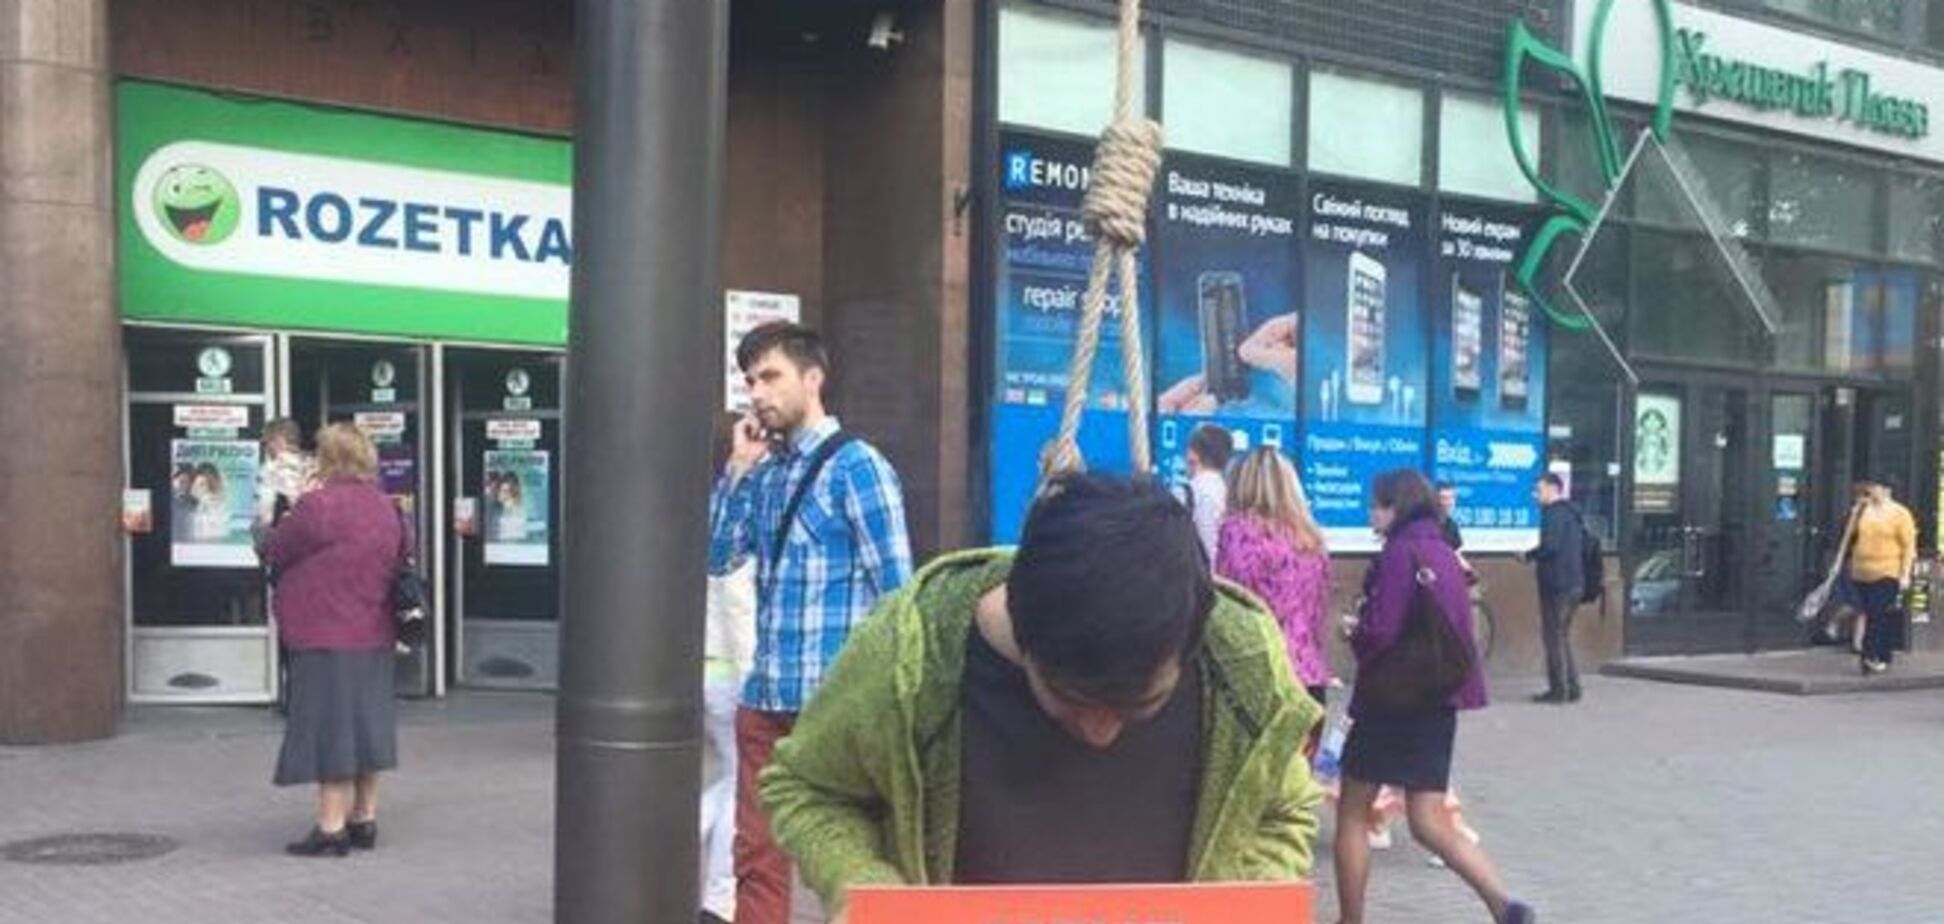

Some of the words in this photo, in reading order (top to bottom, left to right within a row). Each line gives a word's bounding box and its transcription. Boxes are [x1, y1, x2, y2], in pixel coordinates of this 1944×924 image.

[1168, 170, 1209, 198] Ваша
[256, 186, 570, 265] ROZETKA
[1006, 209, 1062, 240] студія
[1250, 214, 1295, 237] руках
[1023, 284, 1078, 313] repair
